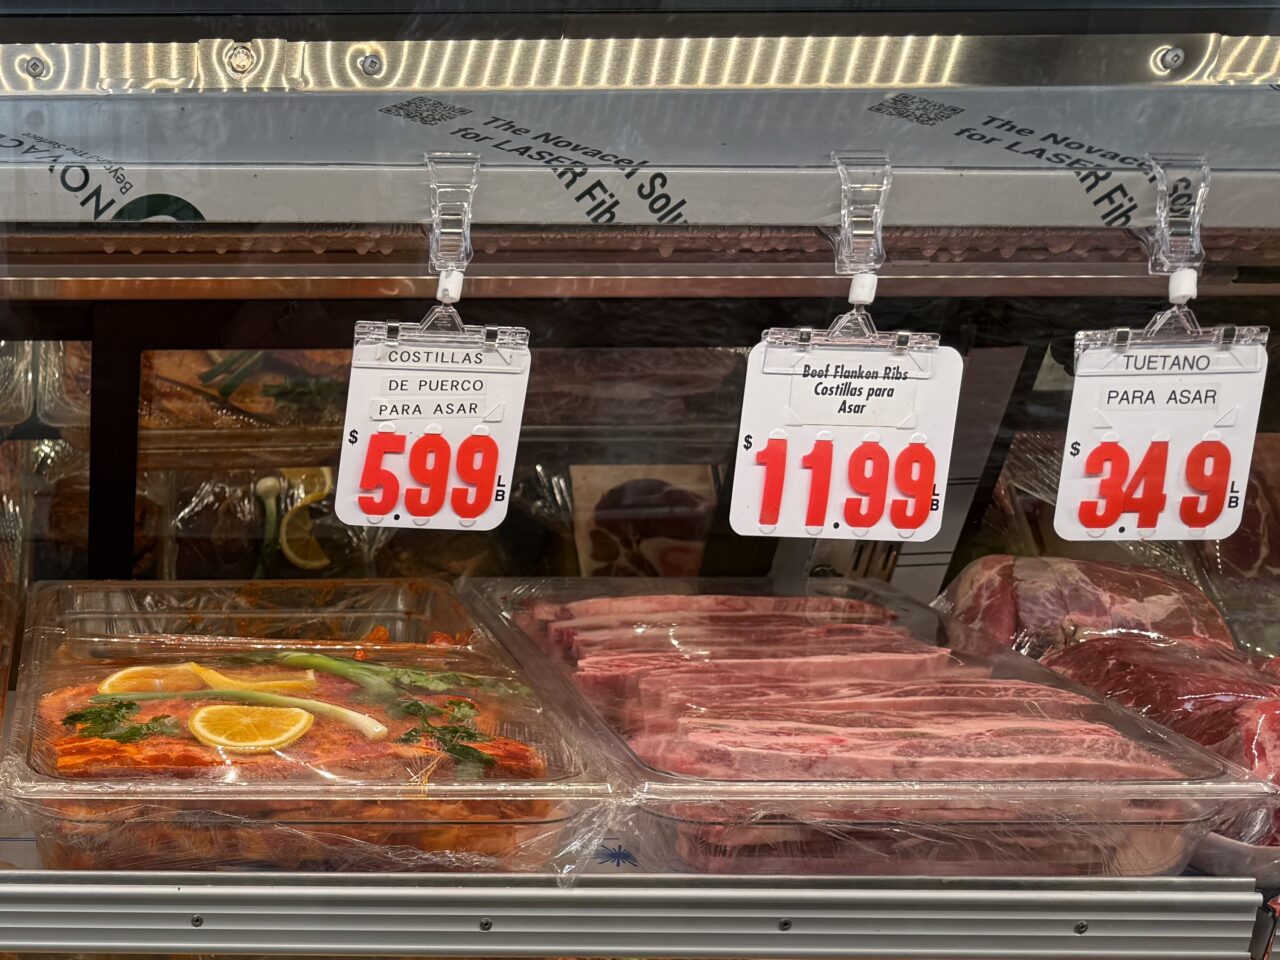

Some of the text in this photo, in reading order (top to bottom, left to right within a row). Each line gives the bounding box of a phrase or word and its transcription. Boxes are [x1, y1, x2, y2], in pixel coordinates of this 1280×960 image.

[981, 115, 1035, 137] The
[482, 116, 532, 136] The
[530, 132, 650, 179] Novacel
[449, 127, 493, 143] for
[492, 140, 588, 190] LASER
[953, 127, 1001, 145] for
[1003, 141, 1113, 194] LASER
[388, 351, 483, 364] COSTILLAS
[1123, 355, 1210, 370] TUETANO
[833, 366, 879, 380] Flanken
[883, 367, 908, 380] Ribs
[389, 380, 484, 391] DE PUERCO
[814, 382, 894, 400] Costillas para
[1107, 390, 1217, 405] PARA ASAR
[379, 403, 478, 415] PARA ASAR
[838, 400, 866, 414] Asar
